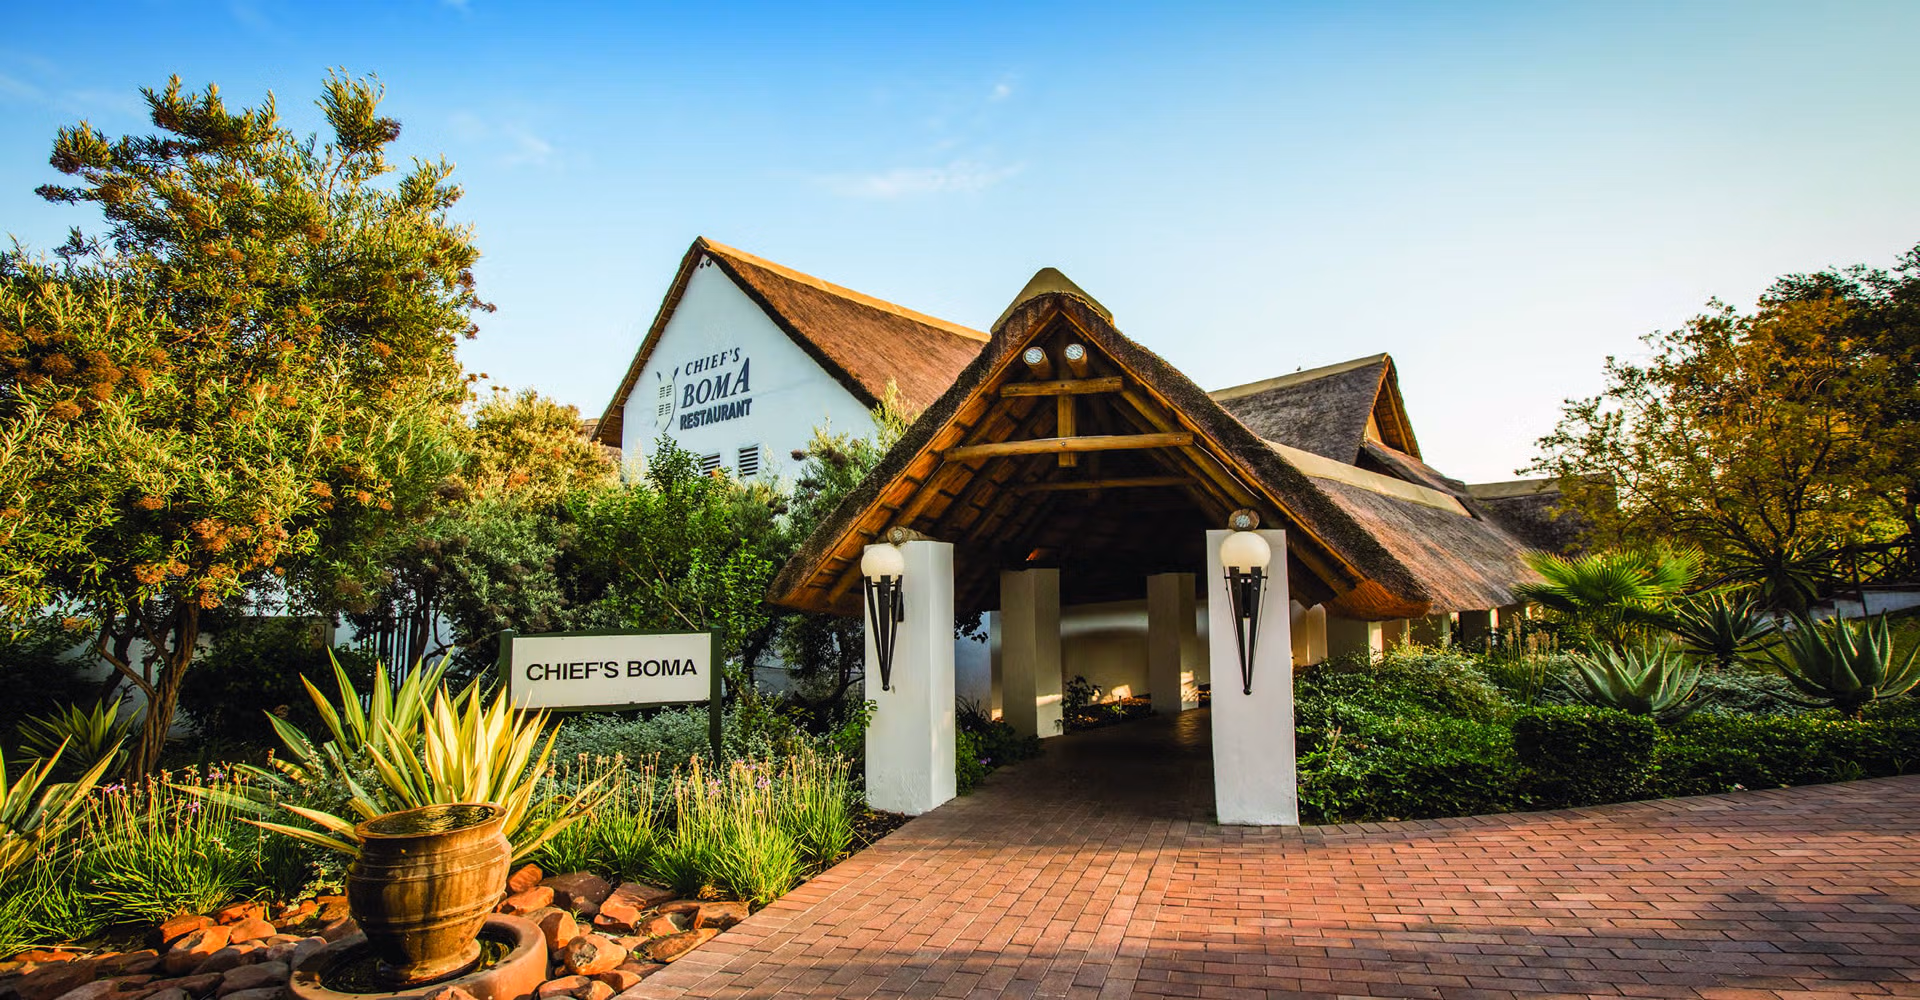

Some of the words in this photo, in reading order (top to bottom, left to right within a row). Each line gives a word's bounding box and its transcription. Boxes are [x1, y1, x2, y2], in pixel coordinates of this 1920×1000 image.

[685, 347, 741, 376] CHIEF'S
[680, 357, 751, 409] BOMA
[680, 398, 753, 431] RESTAURANT
[526, 660, 620, 681] CHIEF'S
[627, 659, 698, 678] BOMA
